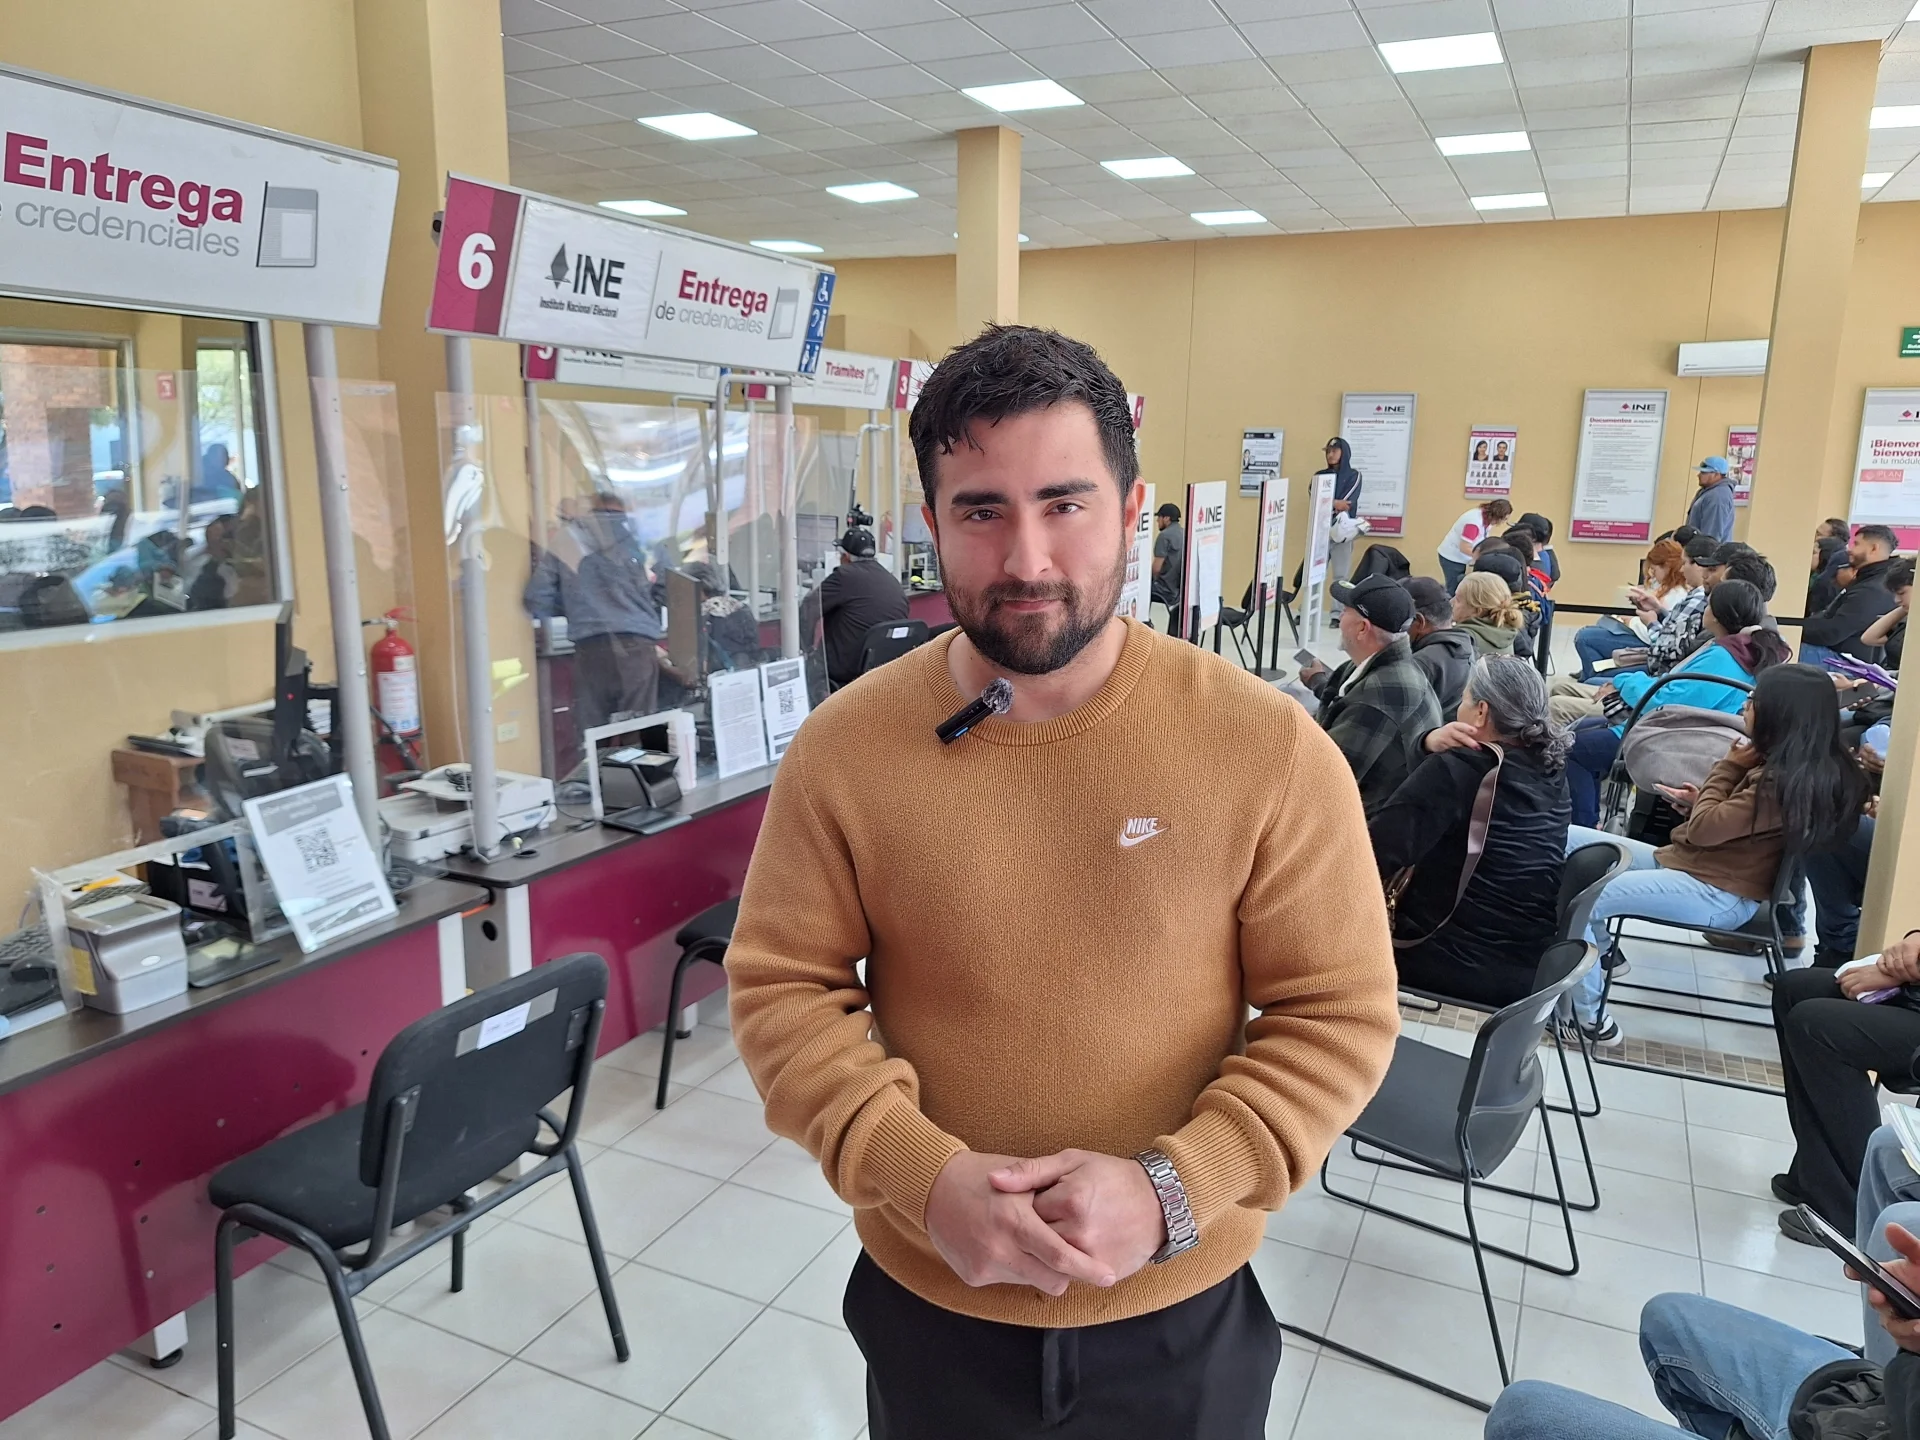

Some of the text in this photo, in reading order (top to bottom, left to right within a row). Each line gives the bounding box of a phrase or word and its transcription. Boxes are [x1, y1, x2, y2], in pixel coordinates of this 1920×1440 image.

[4, 131, 243, 228] Entrega
[15, 202, 240, 257] credenciales
[457, 232, 496, 290] 6
[573, 253, 625, 300] INE
[678, 269, 768, 318] Entrega
[655, 301, 764, 335] de credenciales
[826, 361, 865, 380] Trámites
[899, 375, 908, 396] 3
[1384, 405, 1405, 413] INE
[1891, 456, 1920, 465] módul
[1205, 505, 1222, 524] INE
[1273, 498, 1285, 514] INE
[1126, 817, 1159, 834] NIKE
